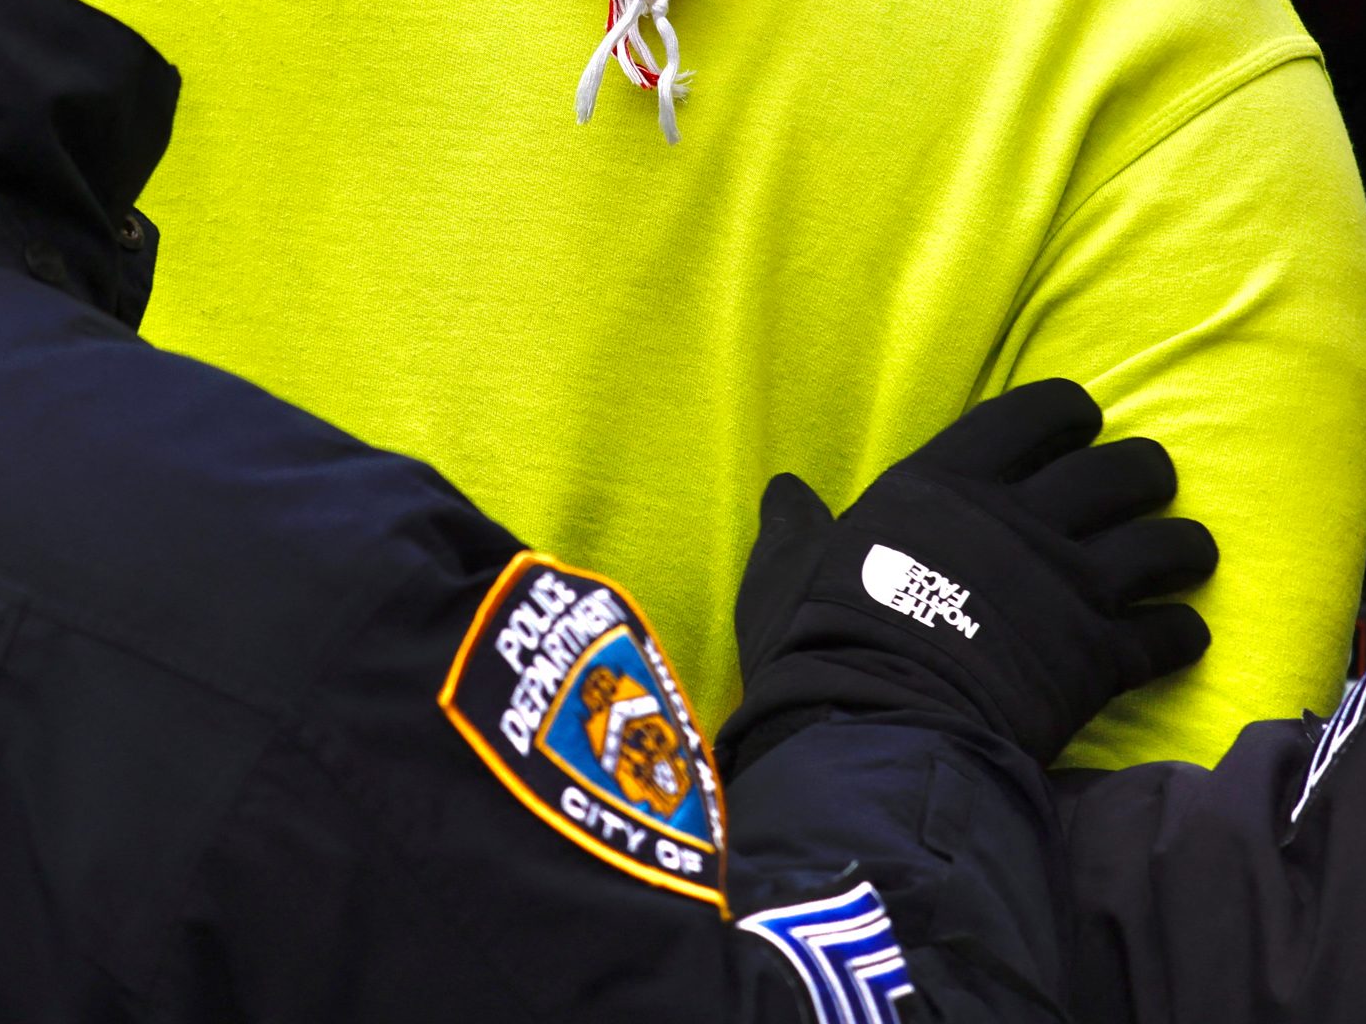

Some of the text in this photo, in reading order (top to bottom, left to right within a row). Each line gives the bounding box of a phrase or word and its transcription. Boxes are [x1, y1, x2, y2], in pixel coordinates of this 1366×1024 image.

[494, 571, 577, 675] POLICE
[888, 589, 936, 628] THE
[896, 575, 981, 639] NORTH
[905, 562, 971, 609] FACE
[499, 588, 628, 757] DEPARTMENT
[560, 786, 647, 853] CITY
[655, 838, 703, 874] OF
